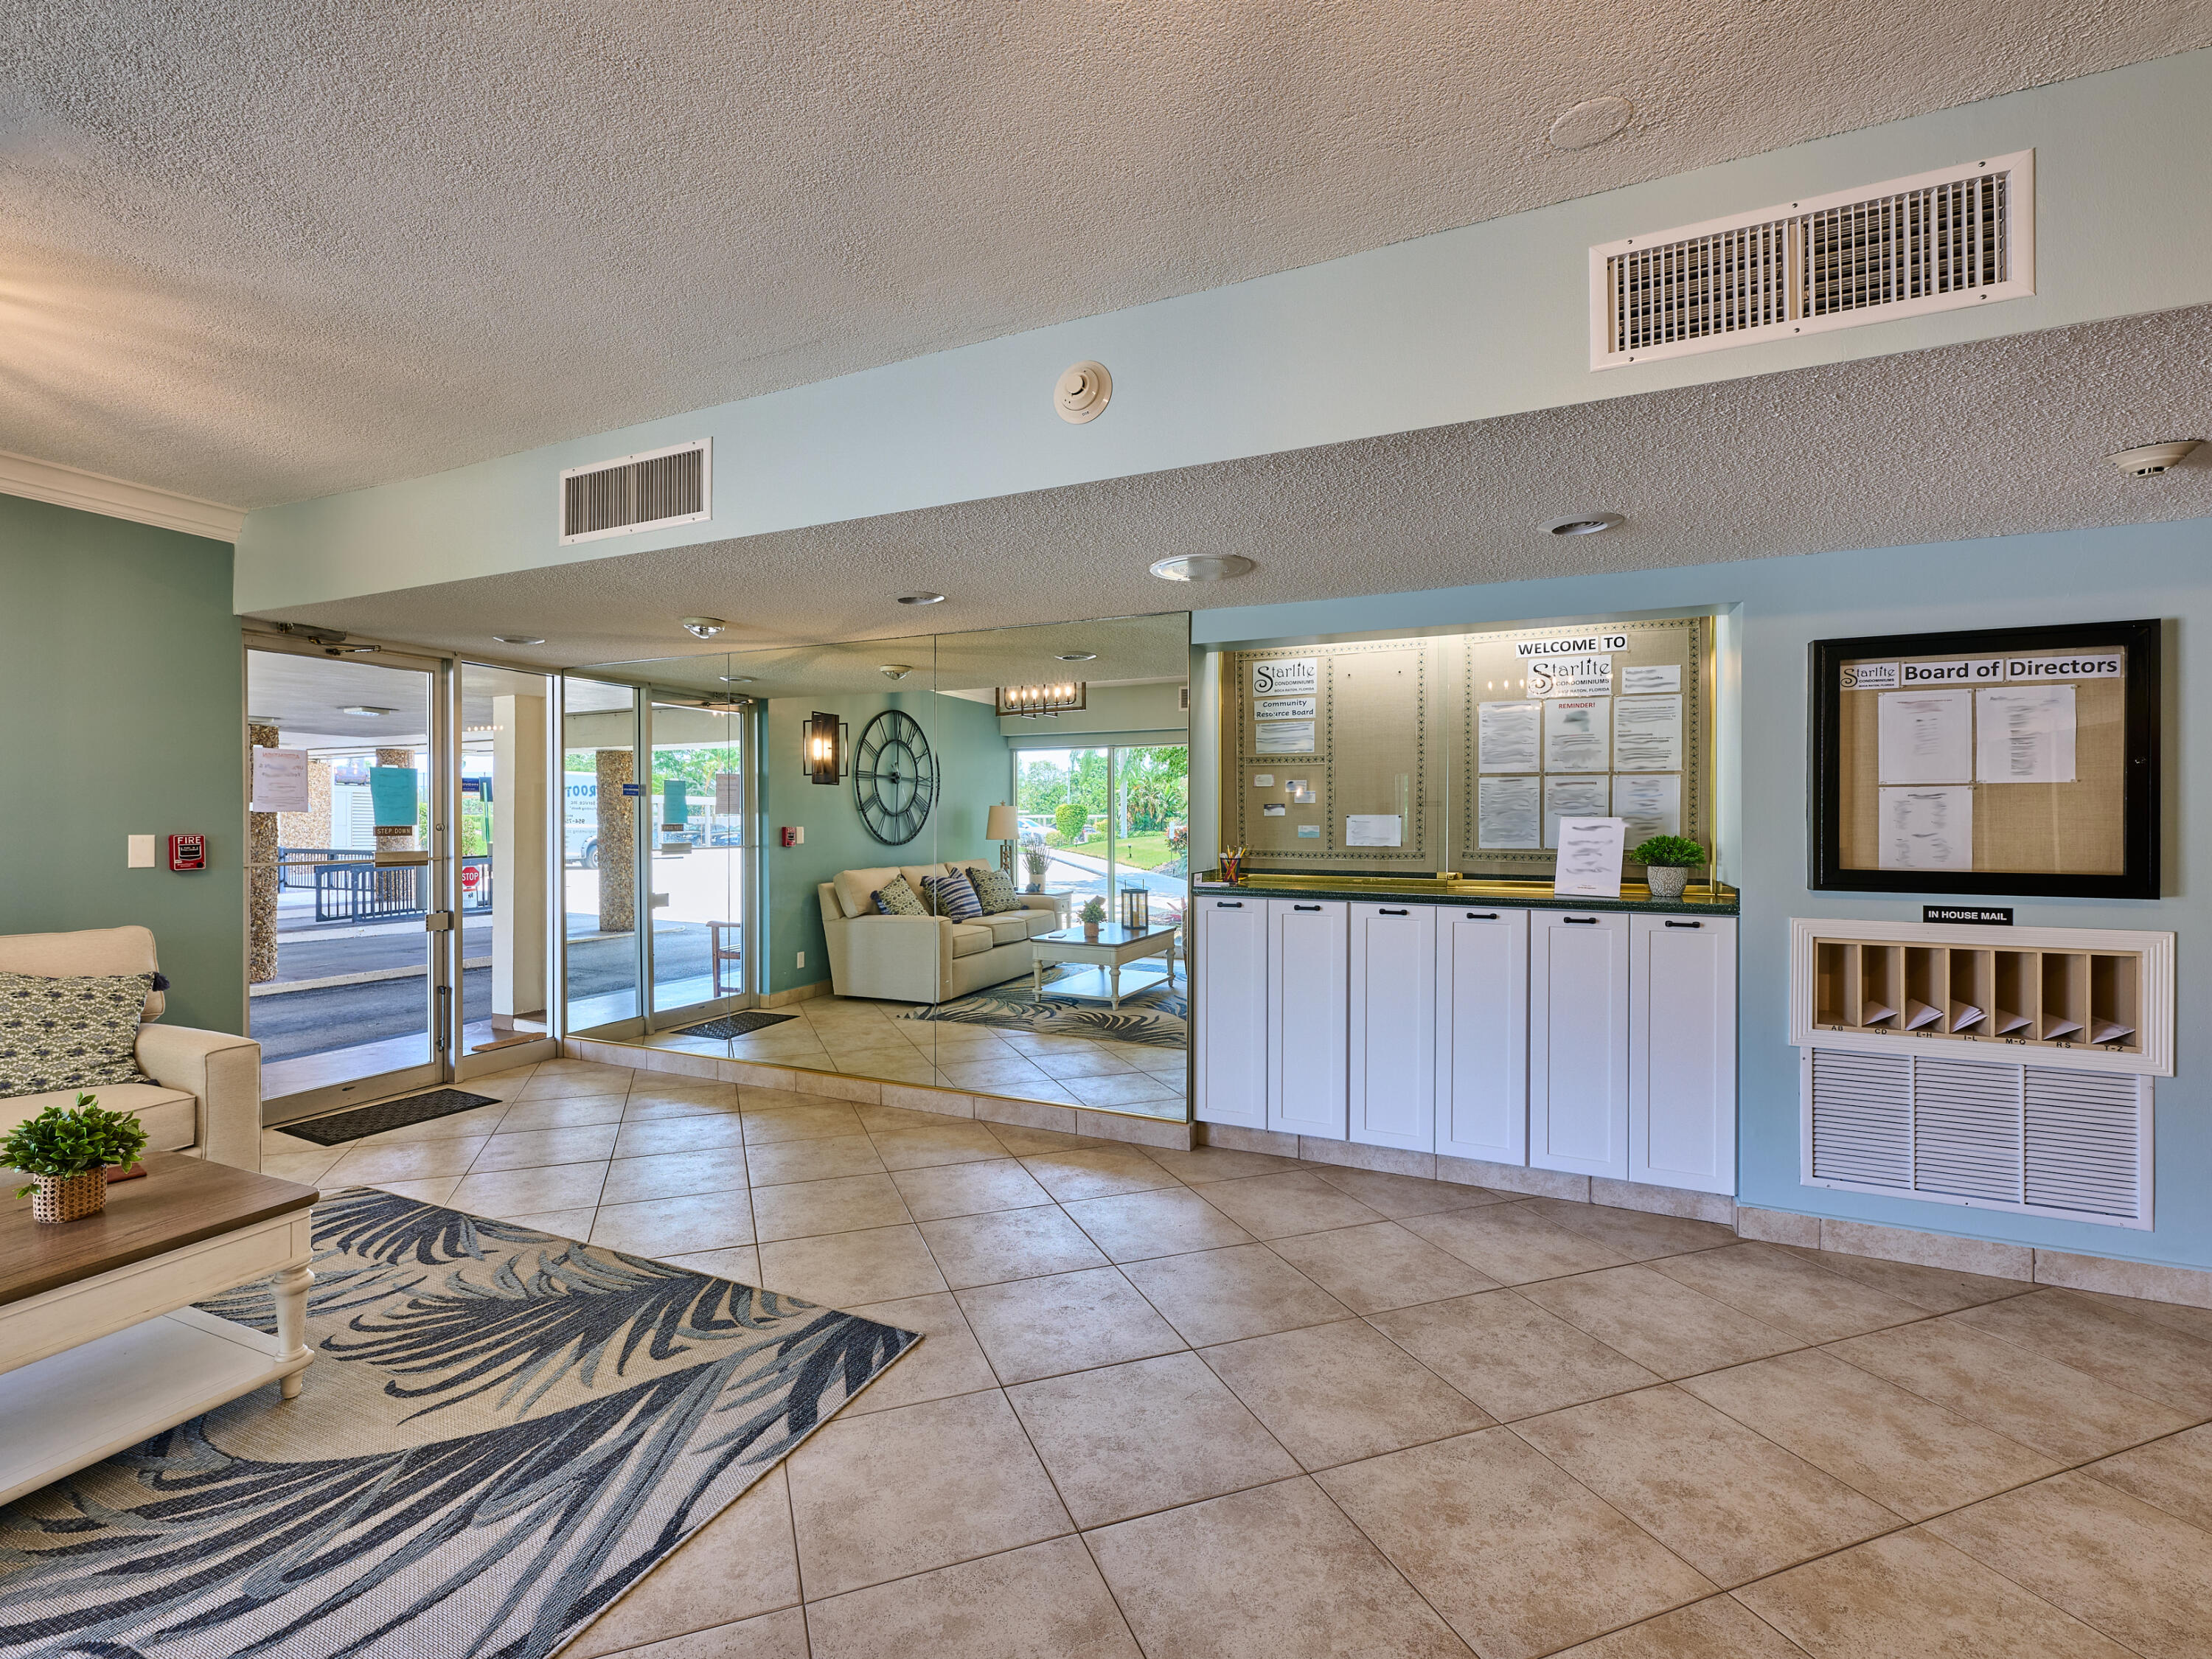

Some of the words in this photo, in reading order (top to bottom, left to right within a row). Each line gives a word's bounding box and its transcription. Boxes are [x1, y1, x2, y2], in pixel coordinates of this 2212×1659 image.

[1518, 639, 1596, 655] WELCOME
[1604, 636, 1626, 649] TO
[1254, 661, 1315, 692] Starlite
[1528, 658, 1610, 695] Starlite
[1840, 666, 1895, 688] Starlite
[1905, 663, 1969, 680] Board
[1976, 661, 2000, 678] of
[2010, 660, 2118, 676] Directors
[1556, 678, 1610, 686] CONDOMINIUMS
[1262, 699, 1307, 708] Community
[178, 836, 201, 844] FIRE
[462, 872, 479, 881] STOP
[1928, 910, 1939, 918] IN
[1941, 911, 1978, 919] HOUSE
[1980, 912, 2007, 921] MAIL
